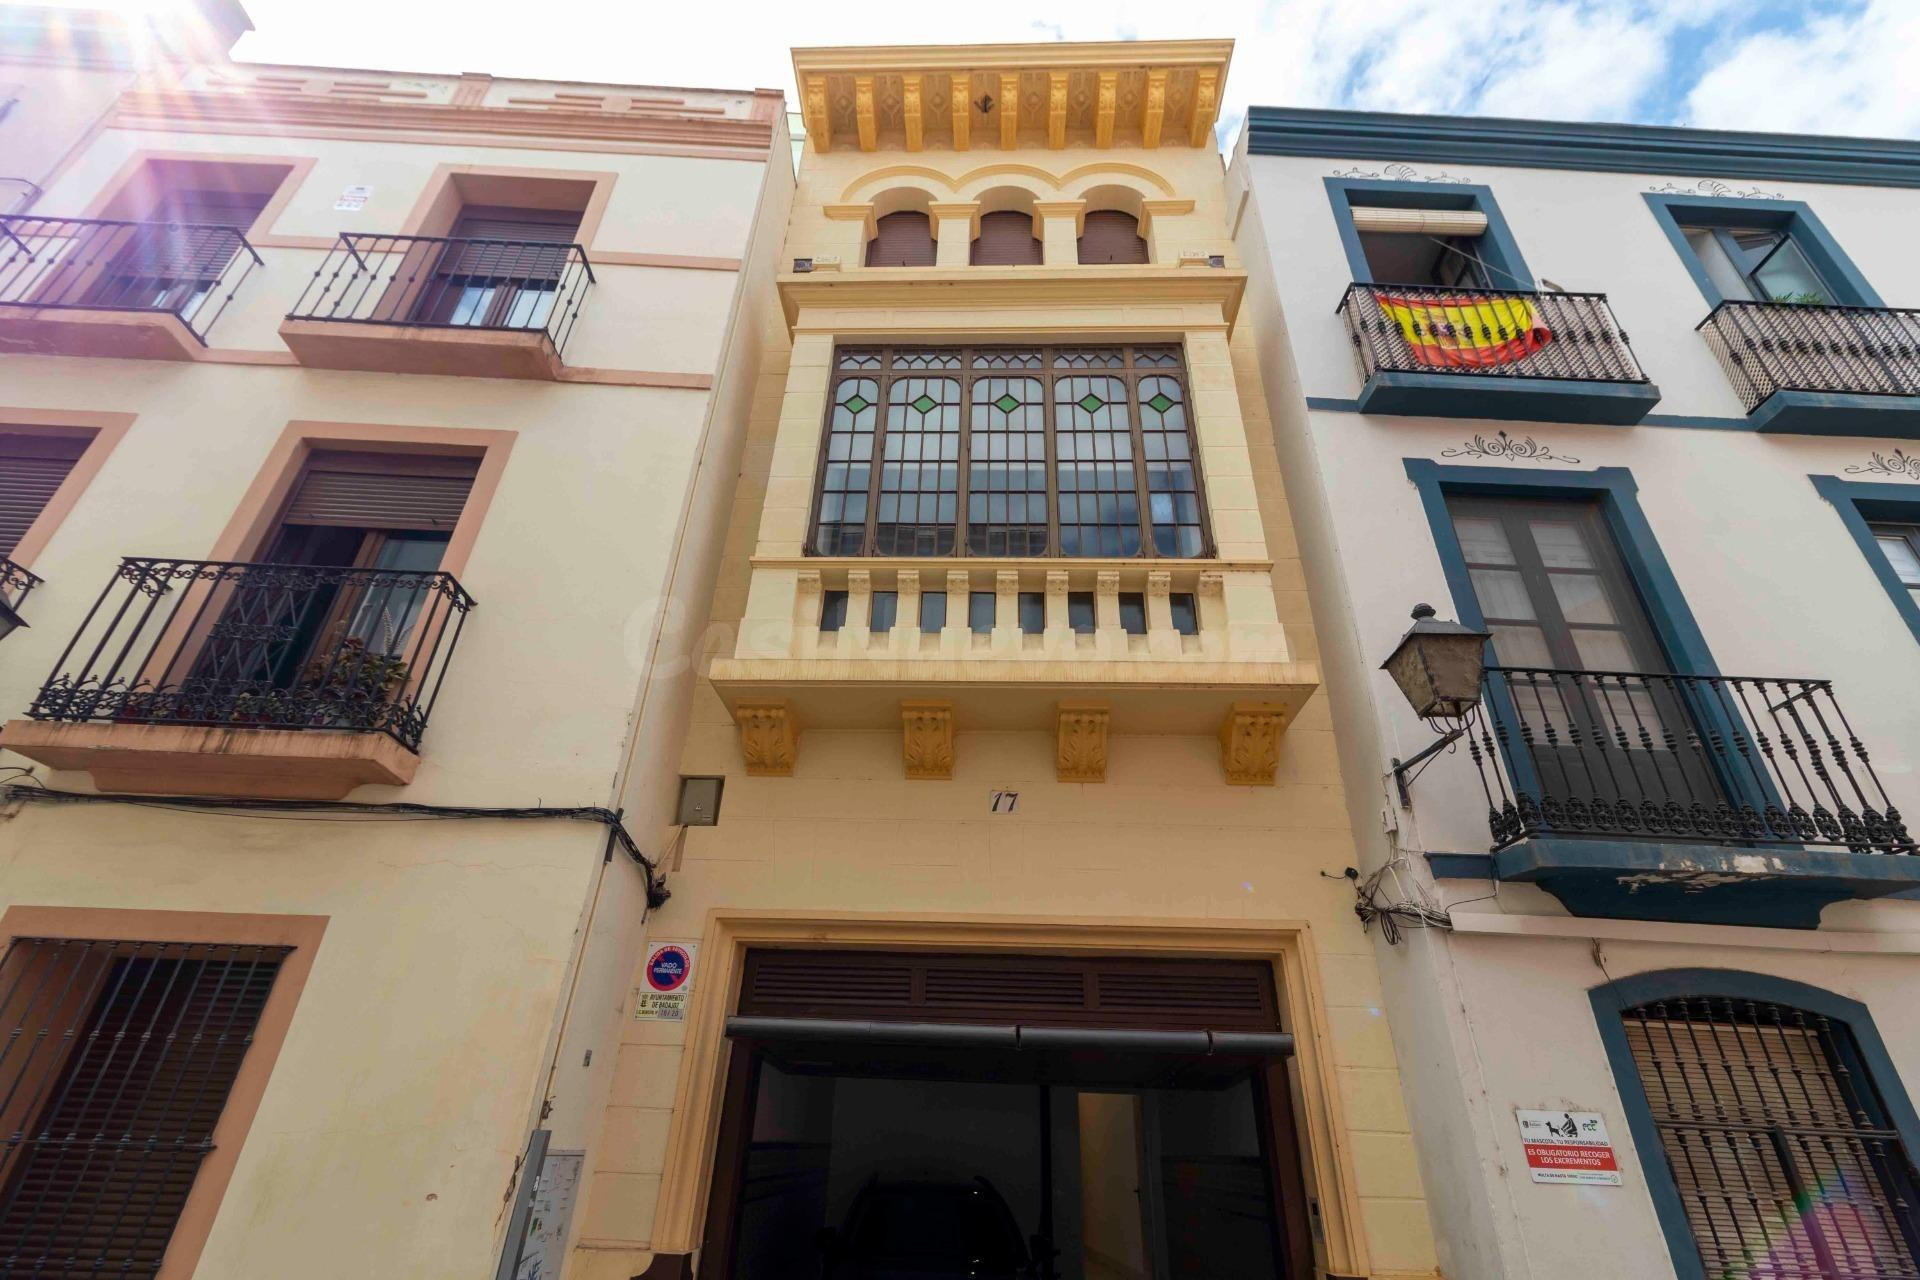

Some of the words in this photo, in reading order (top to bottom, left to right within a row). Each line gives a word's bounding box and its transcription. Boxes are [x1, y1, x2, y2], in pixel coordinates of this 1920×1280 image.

[991, 791, 1019, 813] 17
[653, 967, 683, 975] PERMANENTE
[650, 993, 685, 1002] AYUNTAMIENTO
[659, 1001, 680, 1009] BADAJOZ
[1527, 1148, 1536, 1156] ES
[1536, 1148, 1580, 1158] OBLIGATORIO
[1580, 1151, 1611, 1159] RECOGER
[1540, 1156, 1554, 1164] LOS
[1554, 1157, 1602, 1166] EXCREMENTOS
